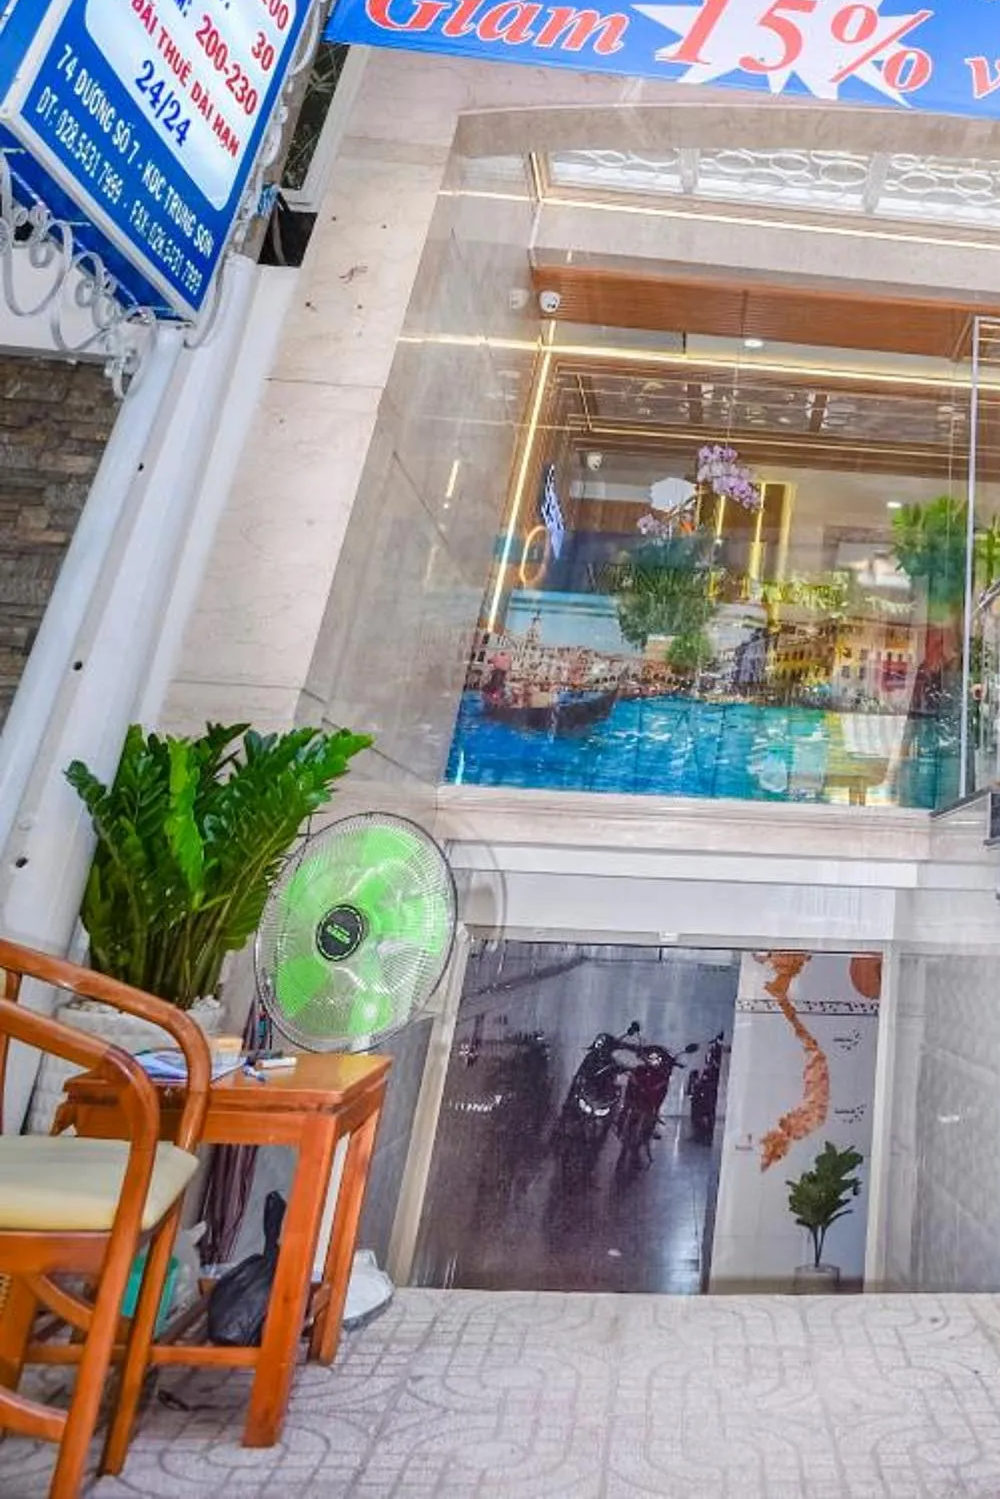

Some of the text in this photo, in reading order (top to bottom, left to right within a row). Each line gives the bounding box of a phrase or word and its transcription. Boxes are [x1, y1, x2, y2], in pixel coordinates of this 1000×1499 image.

[157, 26, 193, 87] THUÊ
[195, 14, 258, 116] 200-230
[251, 31, 276, 72] 30
[56, 43, 79, 83] 74
[127, 139, 141, 165] 7
[135, 59, 192, 147] 24/24
